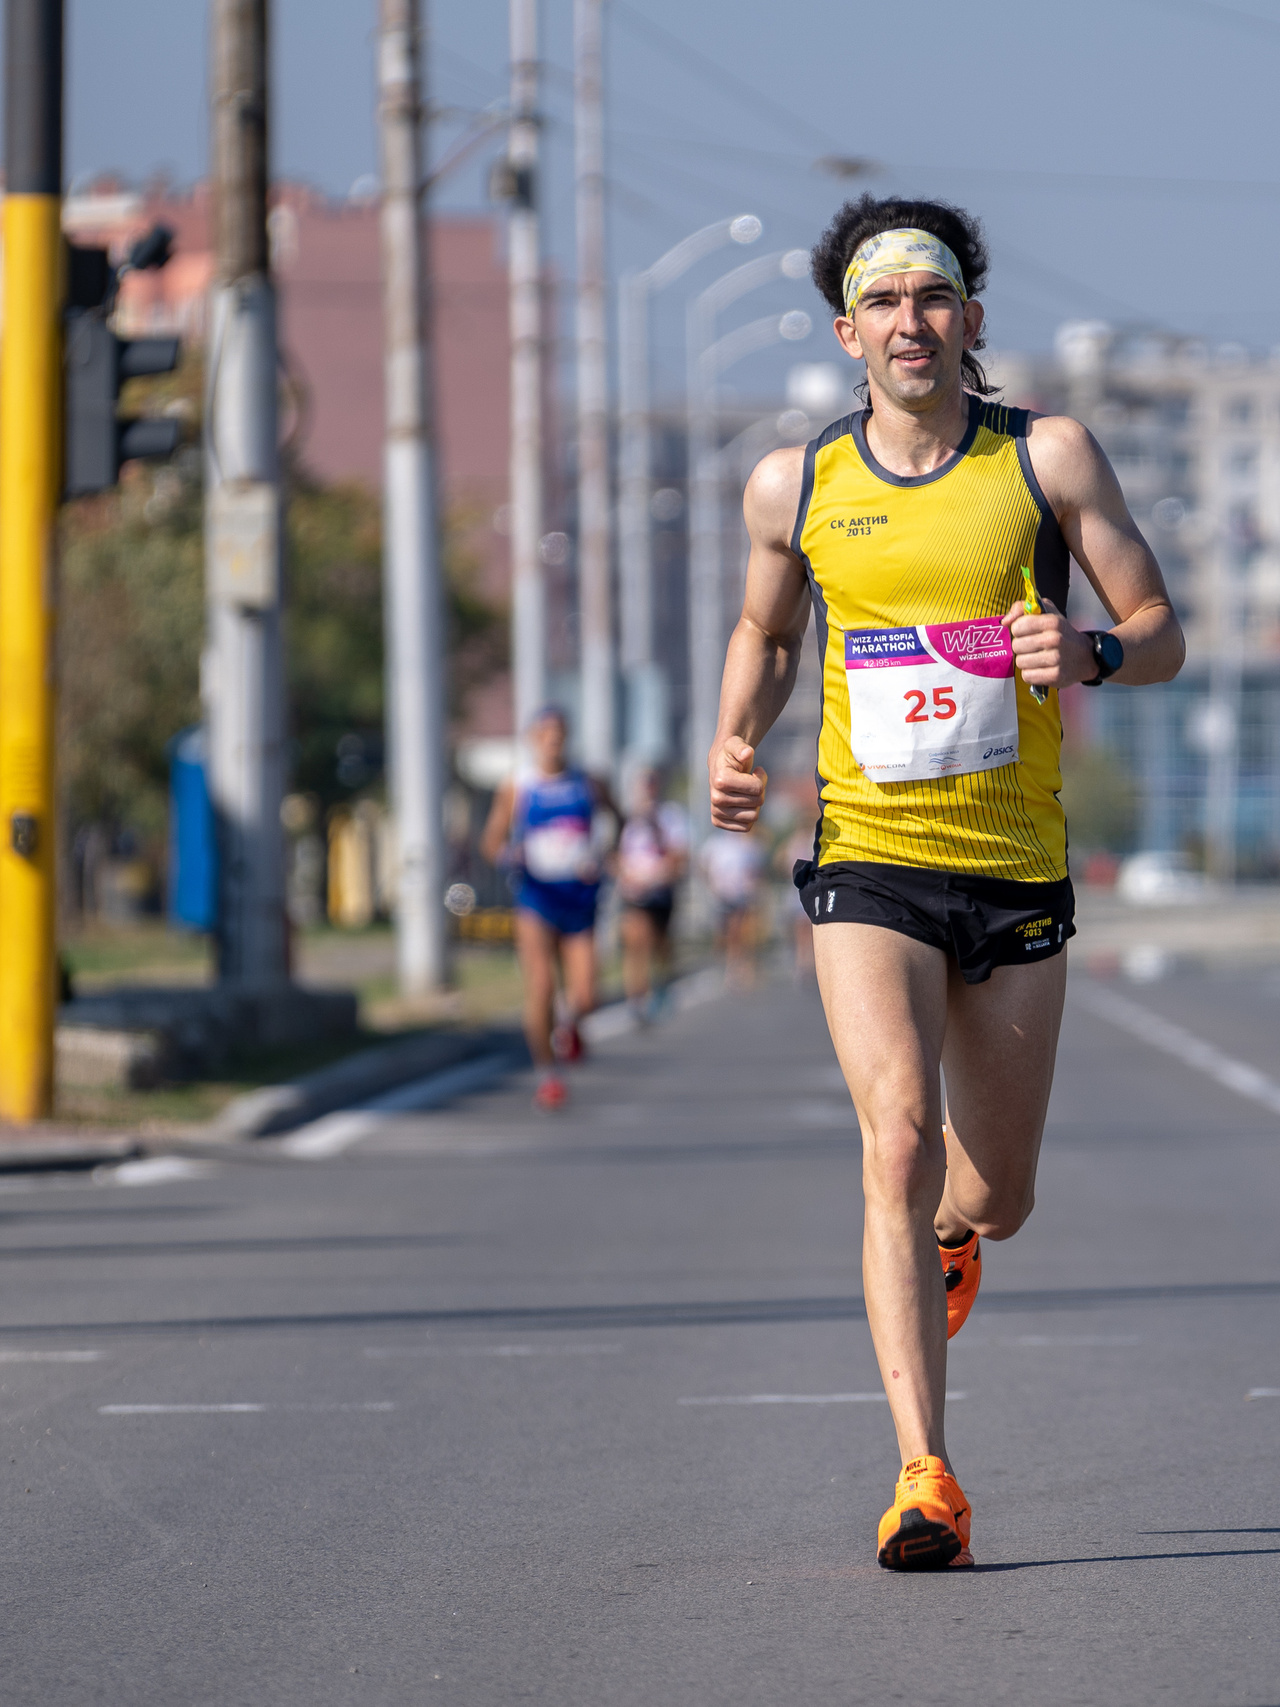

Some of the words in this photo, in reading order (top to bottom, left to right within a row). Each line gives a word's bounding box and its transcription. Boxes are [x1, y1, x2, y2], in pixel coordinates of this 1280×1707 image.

[830, 519, 845, 529] СК
[849, 515, 888, 527] АКТИВ
[846, 527, 872, 537] 2013
[852, 636, 872, 644] WIZZ
[873, 635, 887, 643] AIR
[889, 633, 915, 642] SOFIA
[852, 641, 916, 655] MARATHON
[958, 649, 1008, 662] wizzair.com
[863, 658, 890, 668] 42.195
[903, 686, 957, 724] 25
[1025, 917, 1052, 930] АКТИВ
[1023, 928, 1042, 937] 2013
